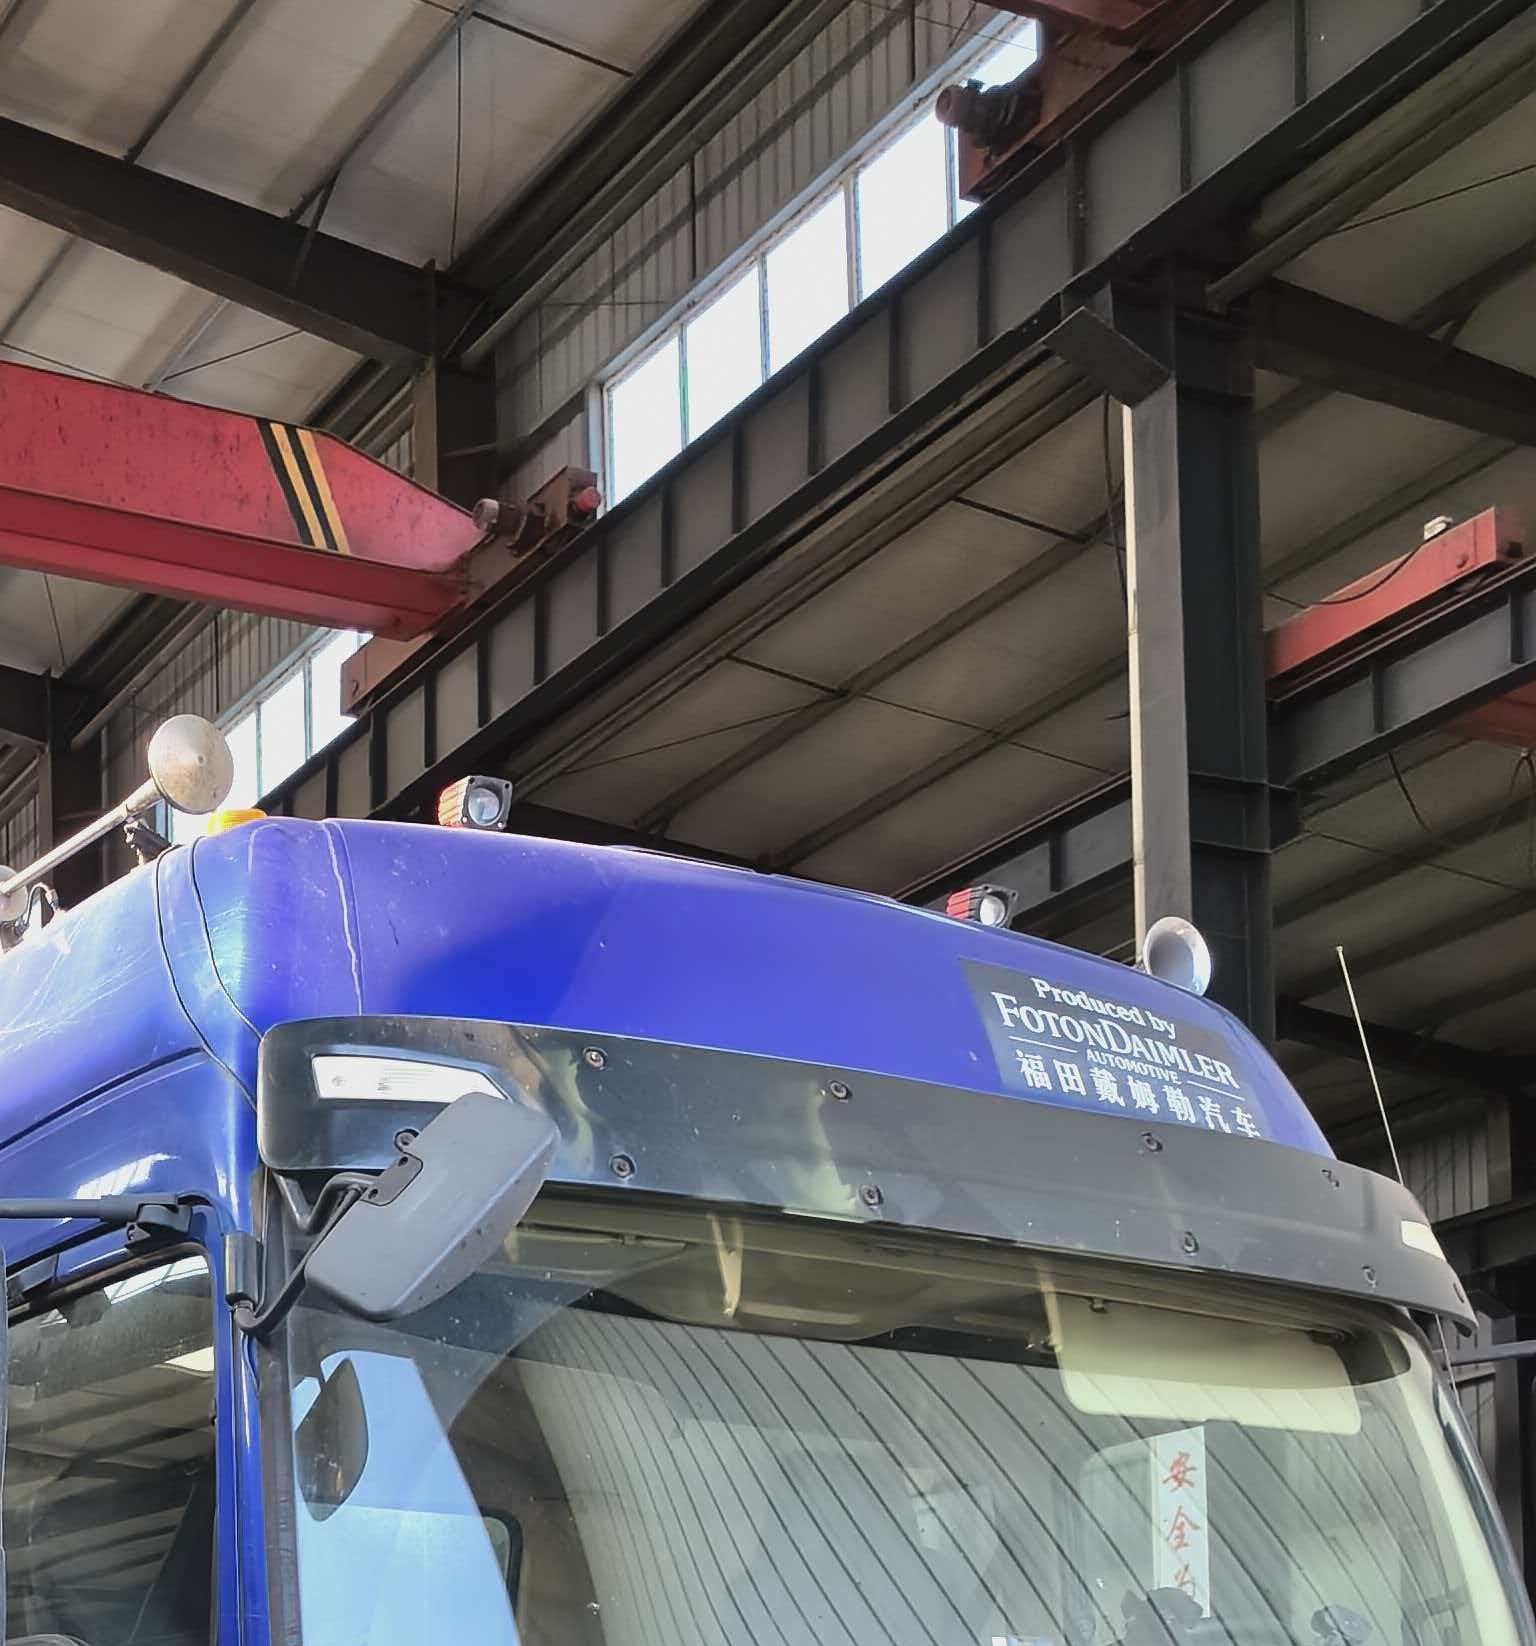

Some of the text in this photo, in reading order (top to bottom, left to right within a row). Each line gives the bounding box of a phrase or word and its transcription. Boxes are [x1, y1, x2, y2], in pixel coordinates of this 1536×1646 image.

[1030, 977, 1177, 1040] Produced by
[1015, 1049, 1262, 1138] 福田戴姆勒汽车
[1086, 1048, 1179, 1085] AUTOMOTIVE
